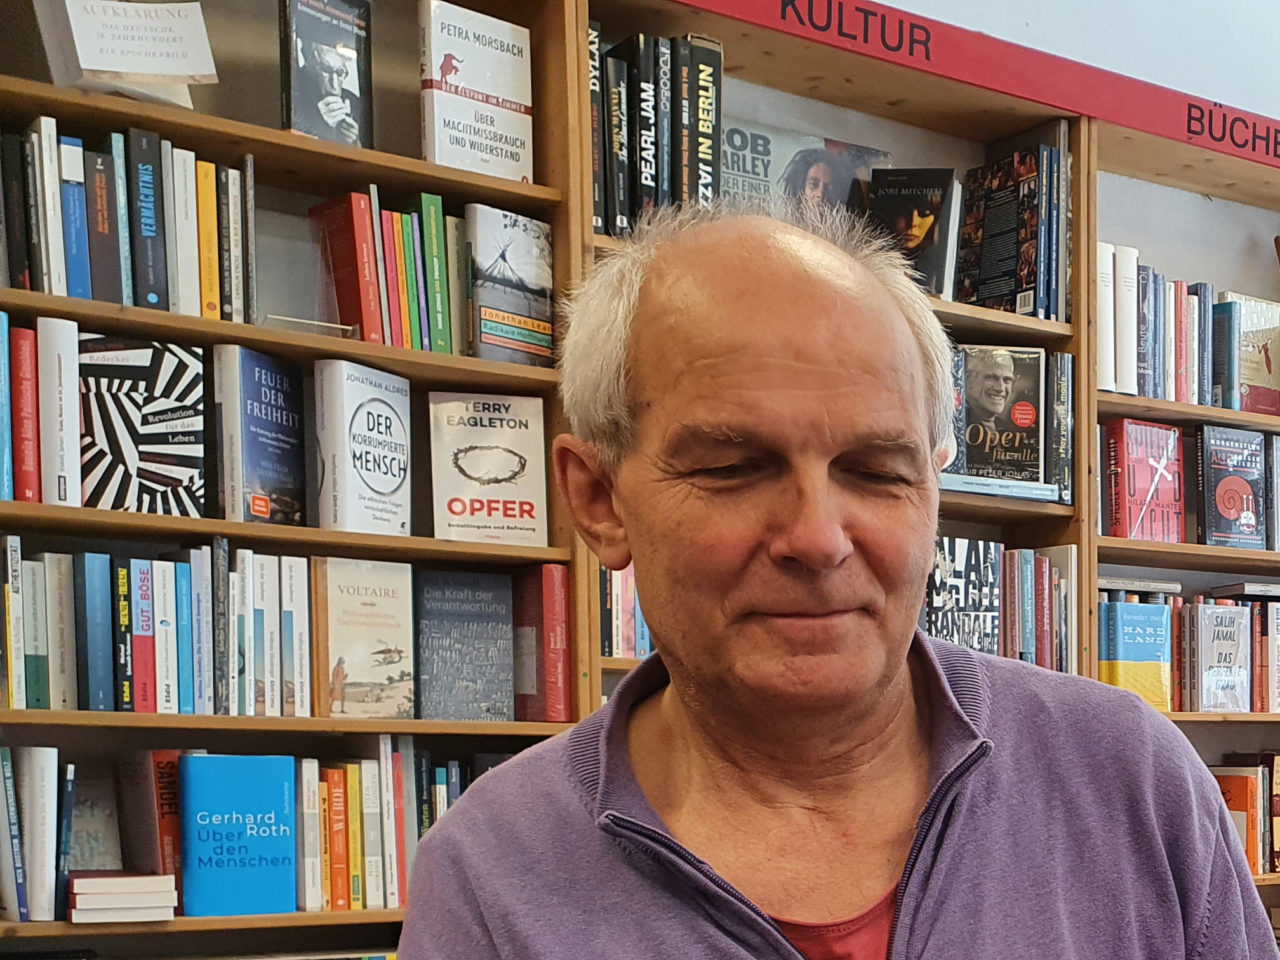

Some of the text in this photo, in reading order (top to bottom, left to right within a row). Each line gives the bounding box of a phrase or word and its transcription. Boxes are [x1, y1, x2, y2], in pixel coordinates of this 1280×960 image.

[780, 0, 932, 61] KULTUR
[440, 22, 523, 58] PETRA MORSBACH
[588, 28, 600, 92] DYLAN
[474, 109, 496, 127] ÜBER
[698, 64, 714, 160] IN BERLIN
[443, 118, 525, 150] MACHTMISSBRAUCH
[641, 82, 656, 187] PEARL JAM
[722, 128, 771, 157] OB
[449, 134, 521, 163] UND WIDERSTAND
[722, 150, 771, 178] ARLEY
[138, 163, 156, 237] VERMÄCHTNIS
[878, 187, 896, 196] JONI
[482, 309, 529, 327] Jonathan
[255, 367, 290, 391] FEUER
[346, 372, 383, 391] JONATHAN
[261, 387, 285, 407] DER
[148, 408, 195, 423] Revolution
[247, 400, 299, 429] FREIHEIT
[465, 401, 512, 414] TERRY
[165, 421, 195, 431] für das
[366, 410, 393, 437] DER
[447, 415, 529, 430] EAGLETON
[169, 434, 195, 443] Leben
[352, 432, 406, 457] KORRUMPIERTE
[965, 423, 1027, 452] Oper
[352, 448, 407, 479] MENSCH
[979, 469, 1002, 478] PETER
[447, 497, 536, 520] OPFER
[140, 568, 150, 631] GUT BÖSE
[338, 584, 398, 600] VOLTAIRE
[424, 588, 493, 601] Die Kraft der
[424, 599, 506, 615] Verantwortung
[1123, 625, 1165, 636] HARD
[1214, 615, 1235, 628] SALIH
[1122, 634, 1165, 645] LAND
[1212, 629, 1236, 643] JAMAL
[1217, 652, 1232, 664] DAS
[156, 760, 178, 820] SANDEL
[197, 810, 275, 825] Gerhard
[332, 786, 344, 831] WÜRDE
[198, 826, 243, 842] Über
[247, 824, 290, 838] Roth
[213, 843, 248, 856] den
[198, 854, 291, 869] Menschen
